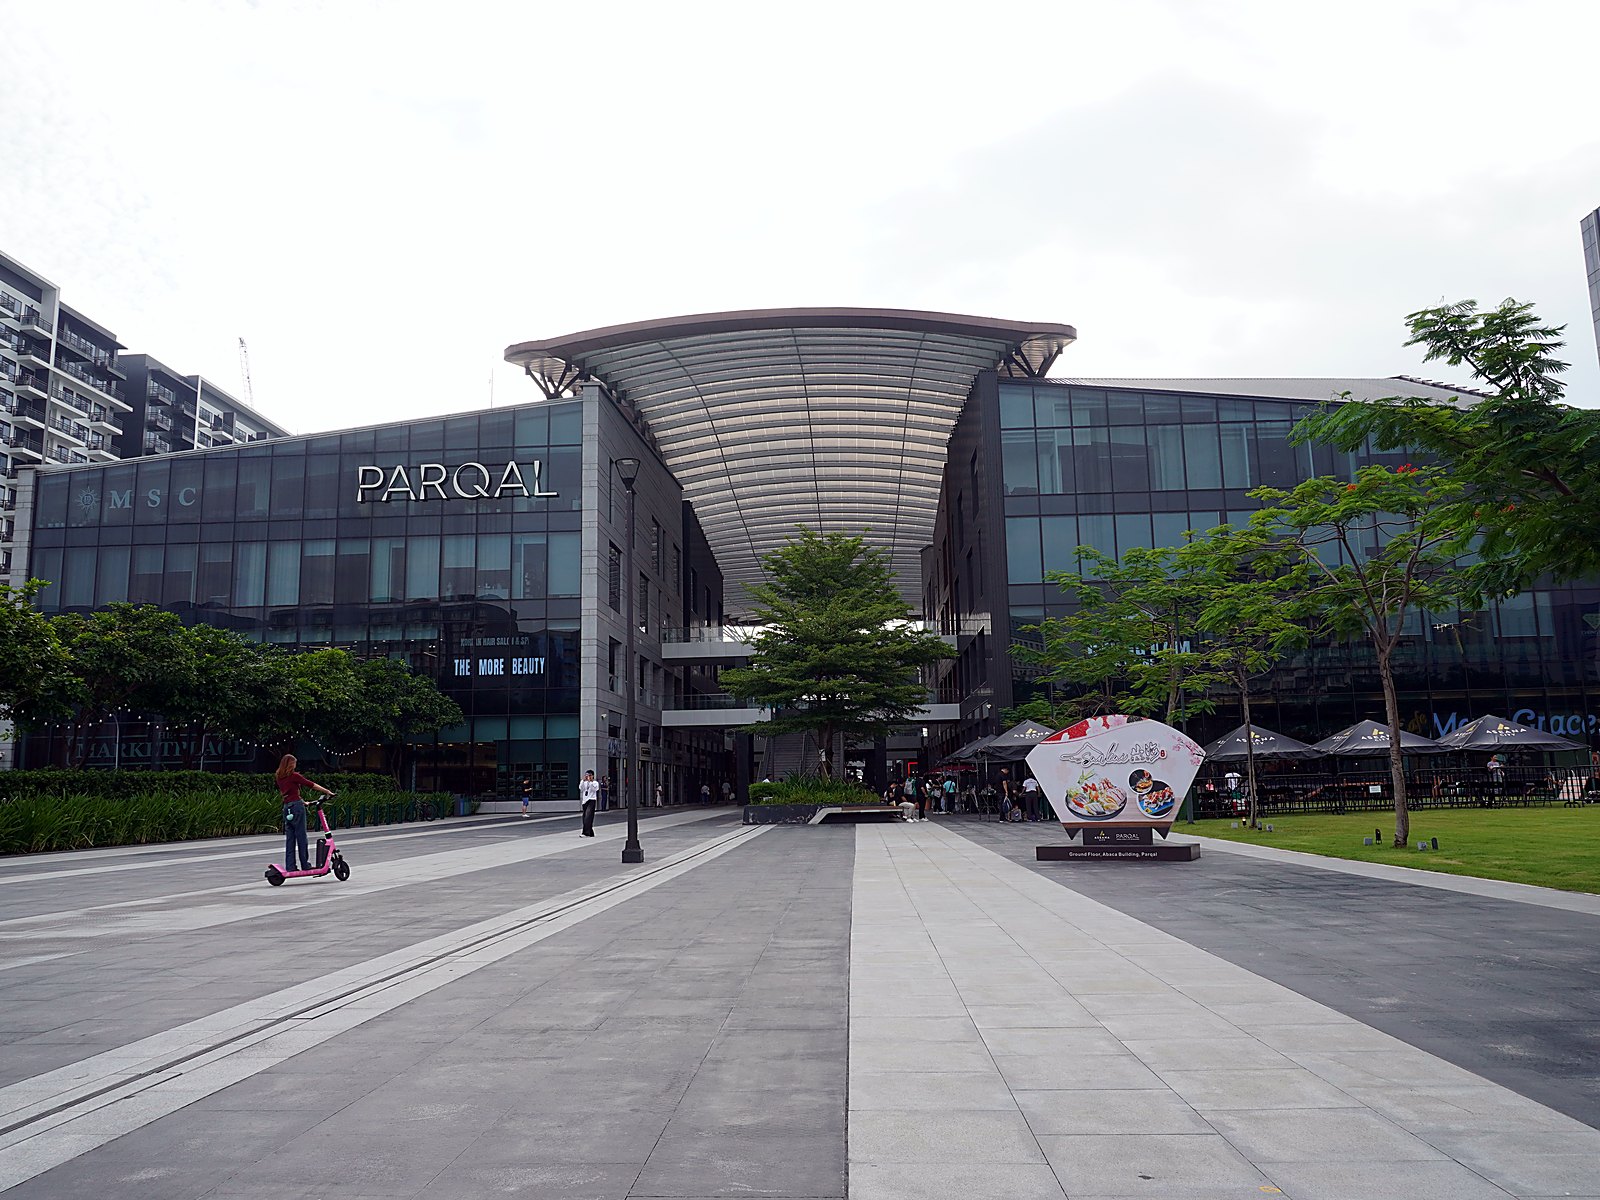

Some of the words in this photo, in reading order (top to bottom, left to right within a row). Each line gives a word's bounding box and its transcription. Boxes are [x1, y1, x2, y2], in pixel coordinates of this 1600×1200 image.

[356, 459, 558, 502] PARQAL
[454, 659, 471, 676] THE
[478, 658, 505, 676] MORE
[512, 657, 545, 675] BEAUTY
